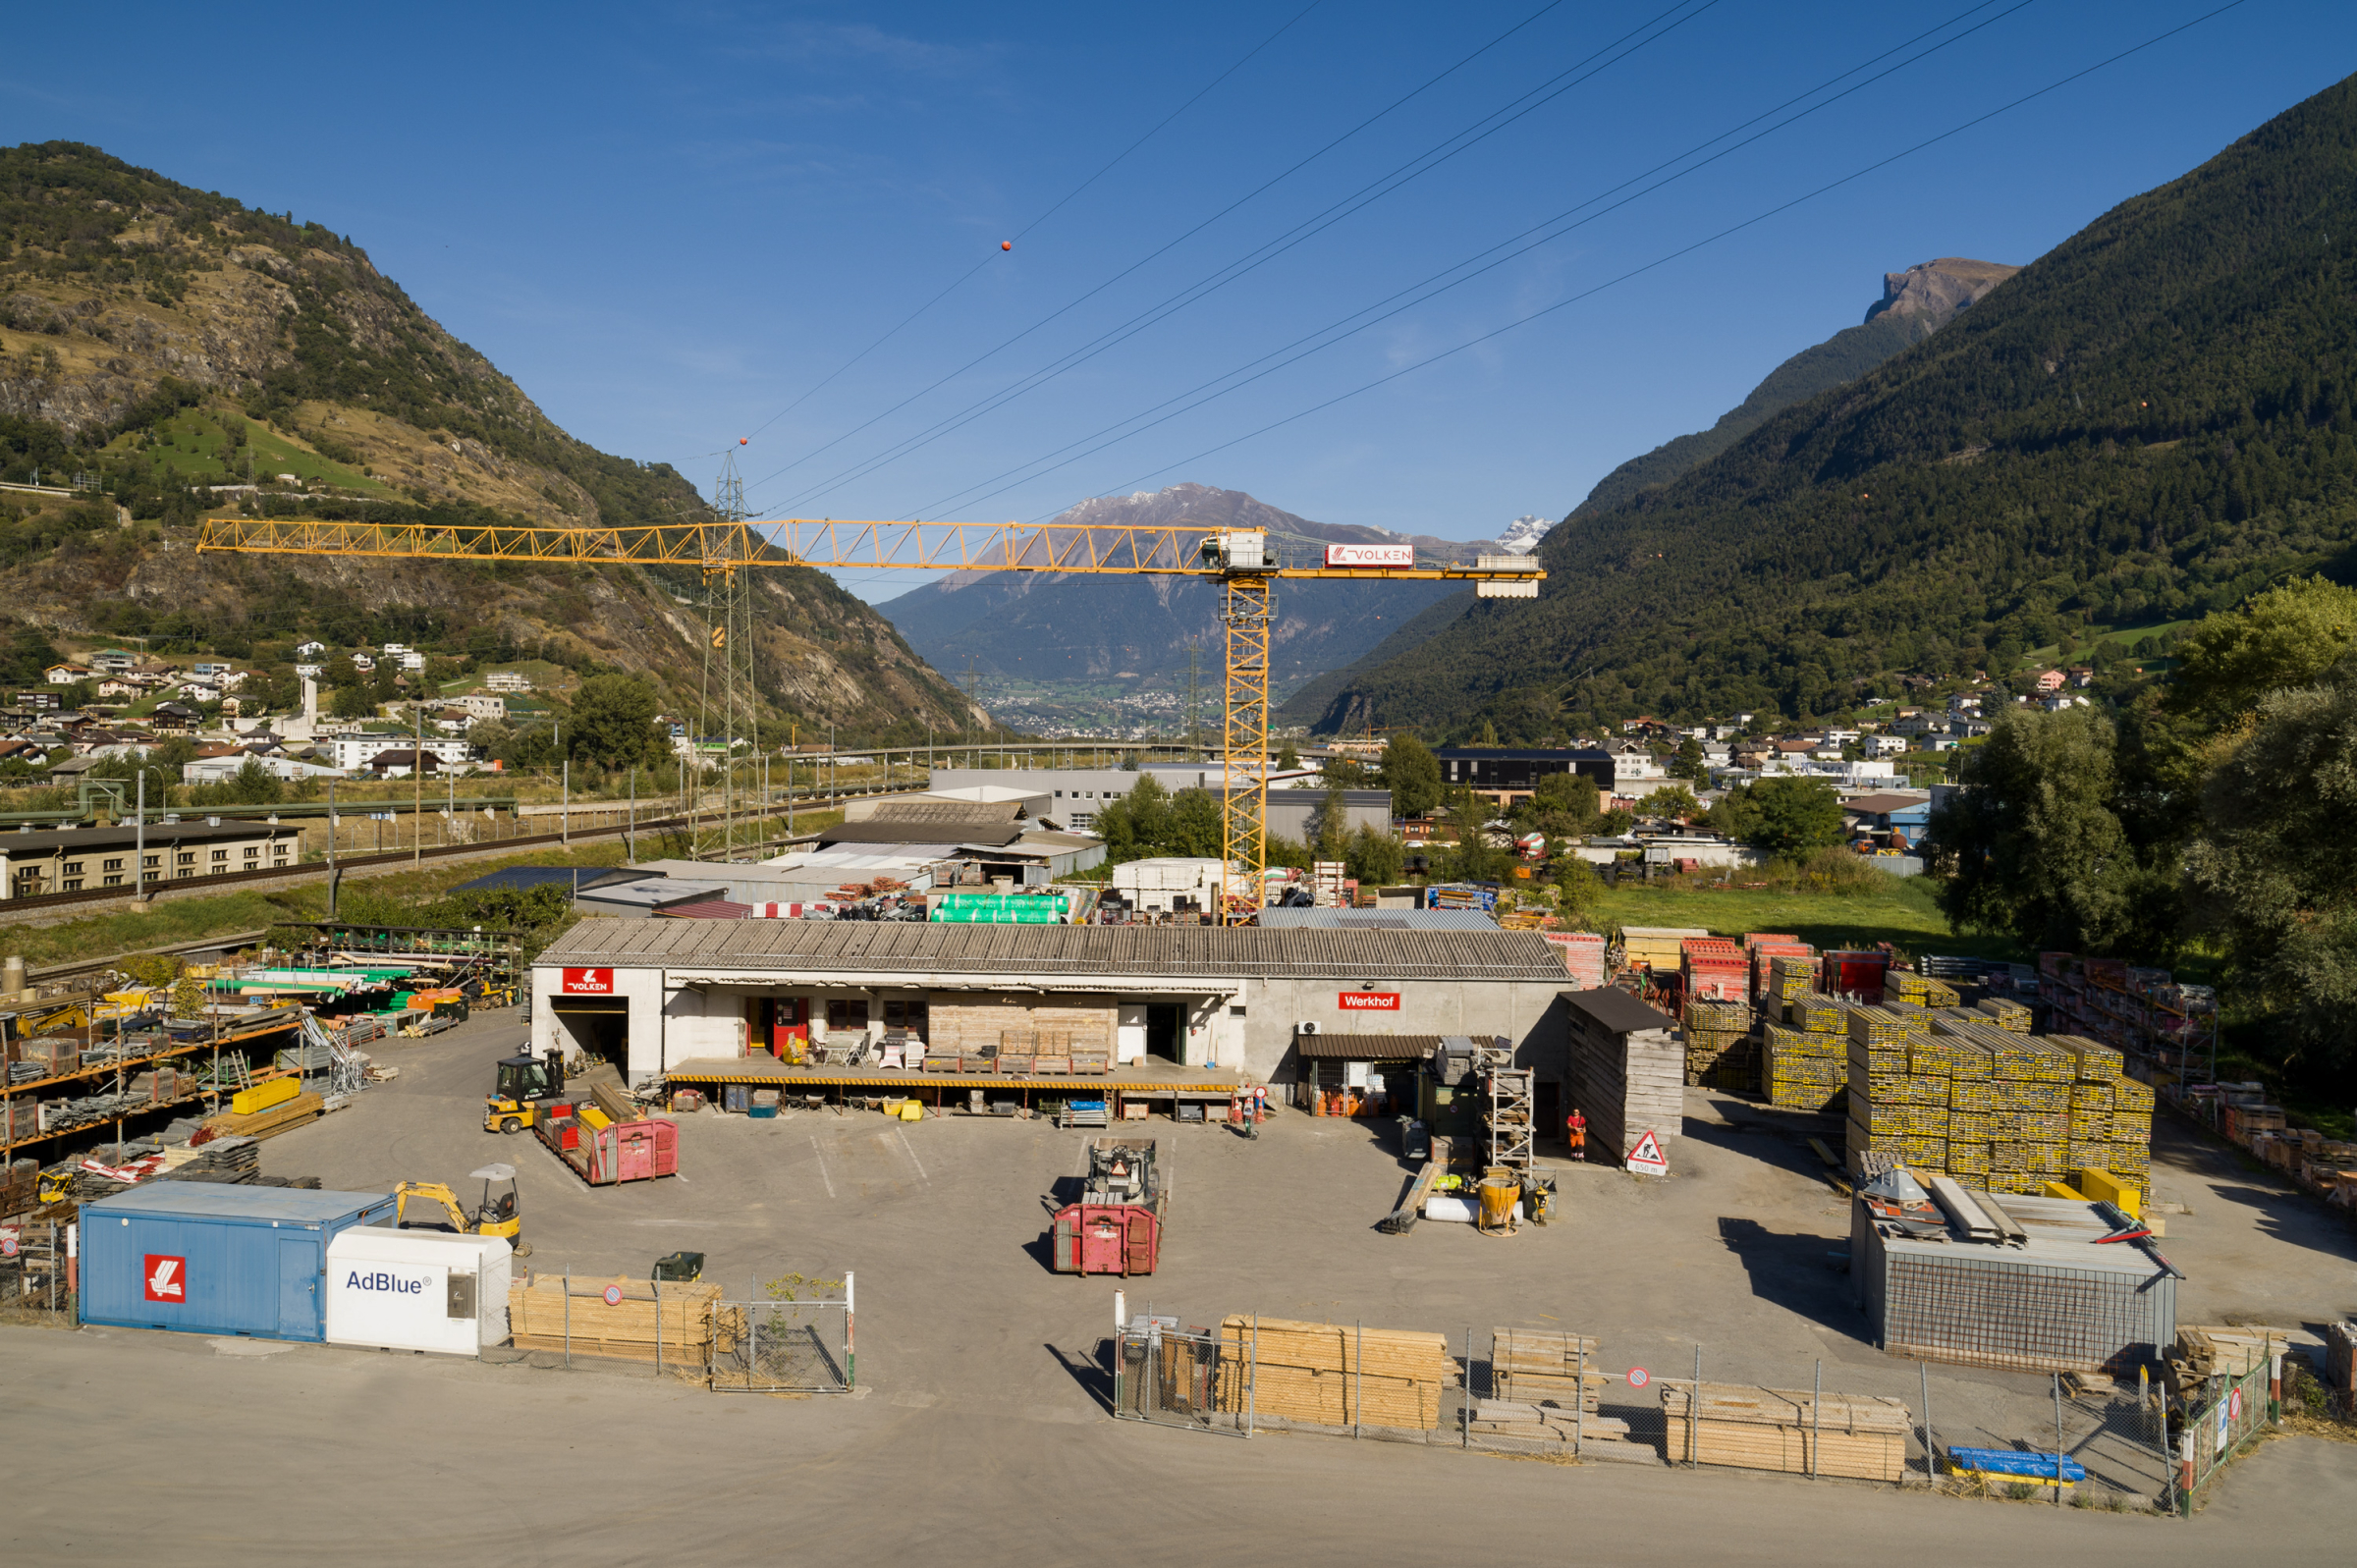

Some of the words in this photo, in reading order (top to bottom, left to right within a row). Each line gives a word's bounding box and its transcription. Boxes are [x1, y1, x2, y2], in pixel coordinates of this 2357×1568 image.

[1347, 550, 1411, 561] VOLKEN
[1344, 996, 1395, 1007] Werkhof
[1634, 1162, 1649, 1172] 650
[2220, 1402, 2226, 1430] P
